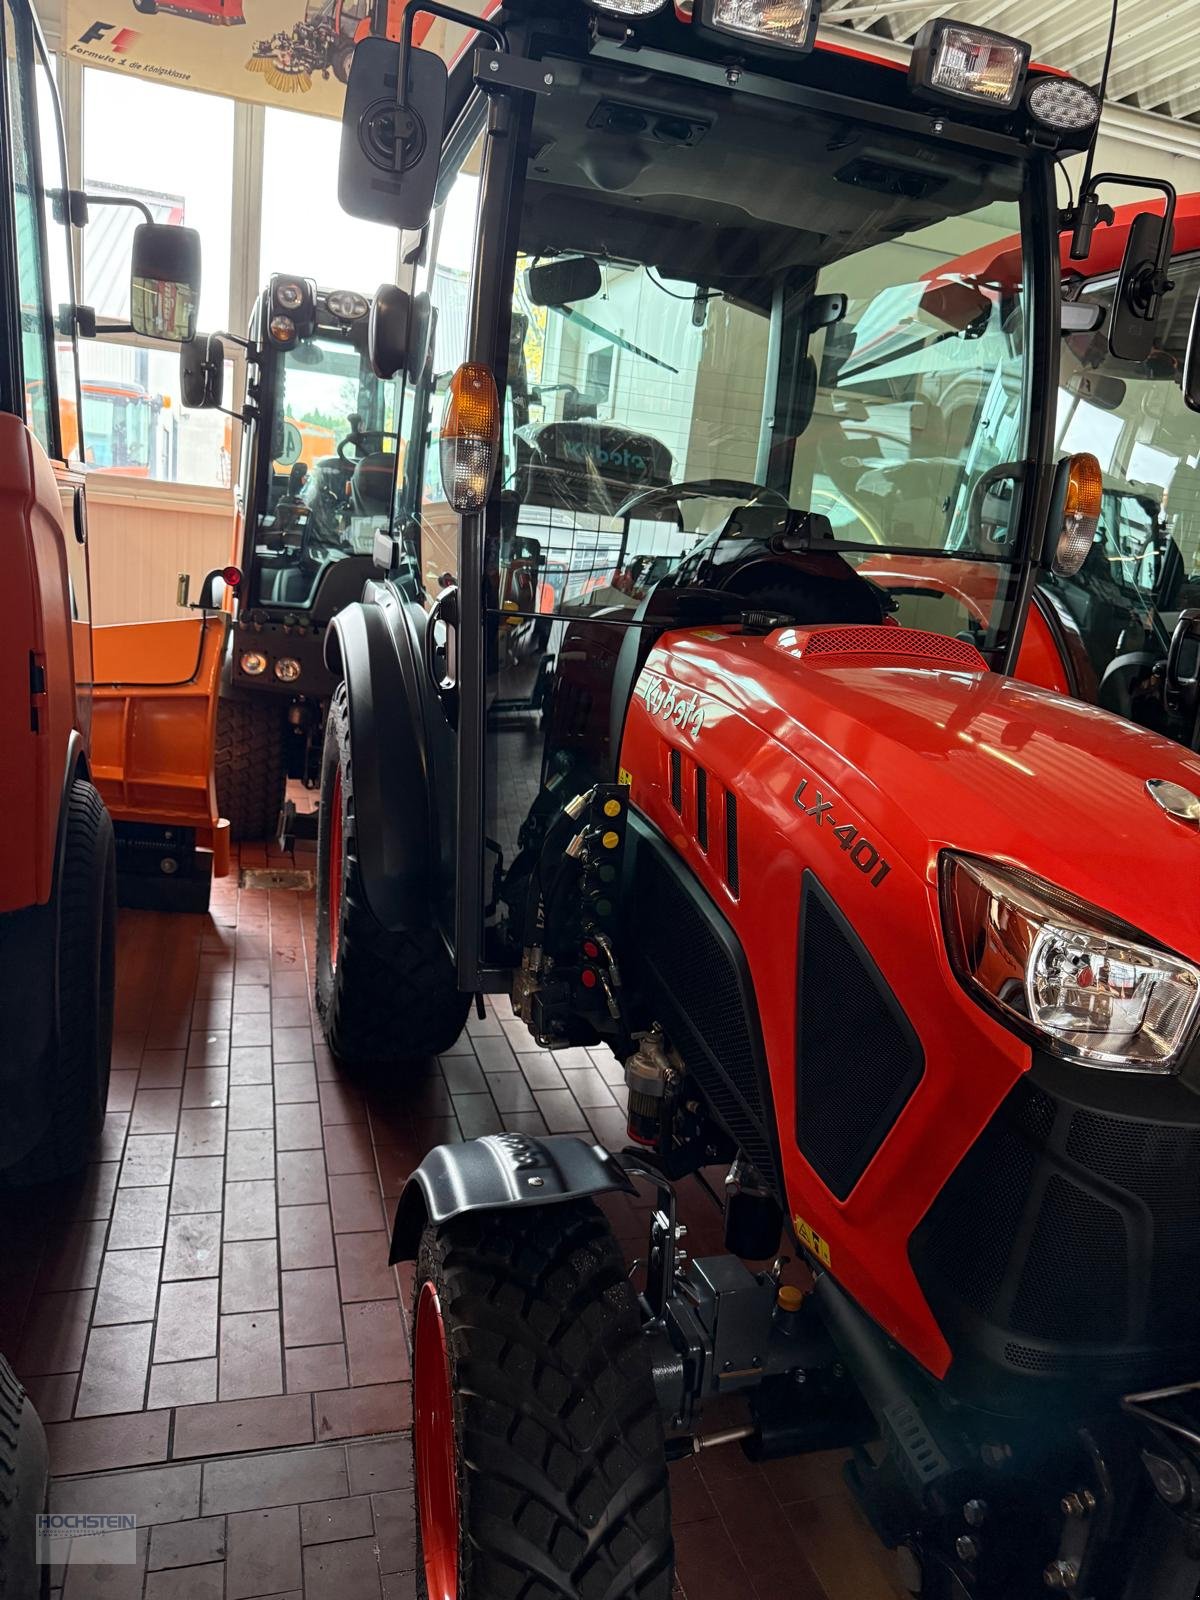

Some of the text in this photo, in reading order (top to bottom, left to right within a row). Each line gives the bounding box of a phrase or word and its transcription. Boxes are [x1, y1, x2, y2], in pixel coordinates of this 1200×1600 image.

[70, 44, 191, 81] Formula 1 die Königsklasse
[644, 676, 705, 738] Kubota
[793, 778, 892, 888] LX-401
